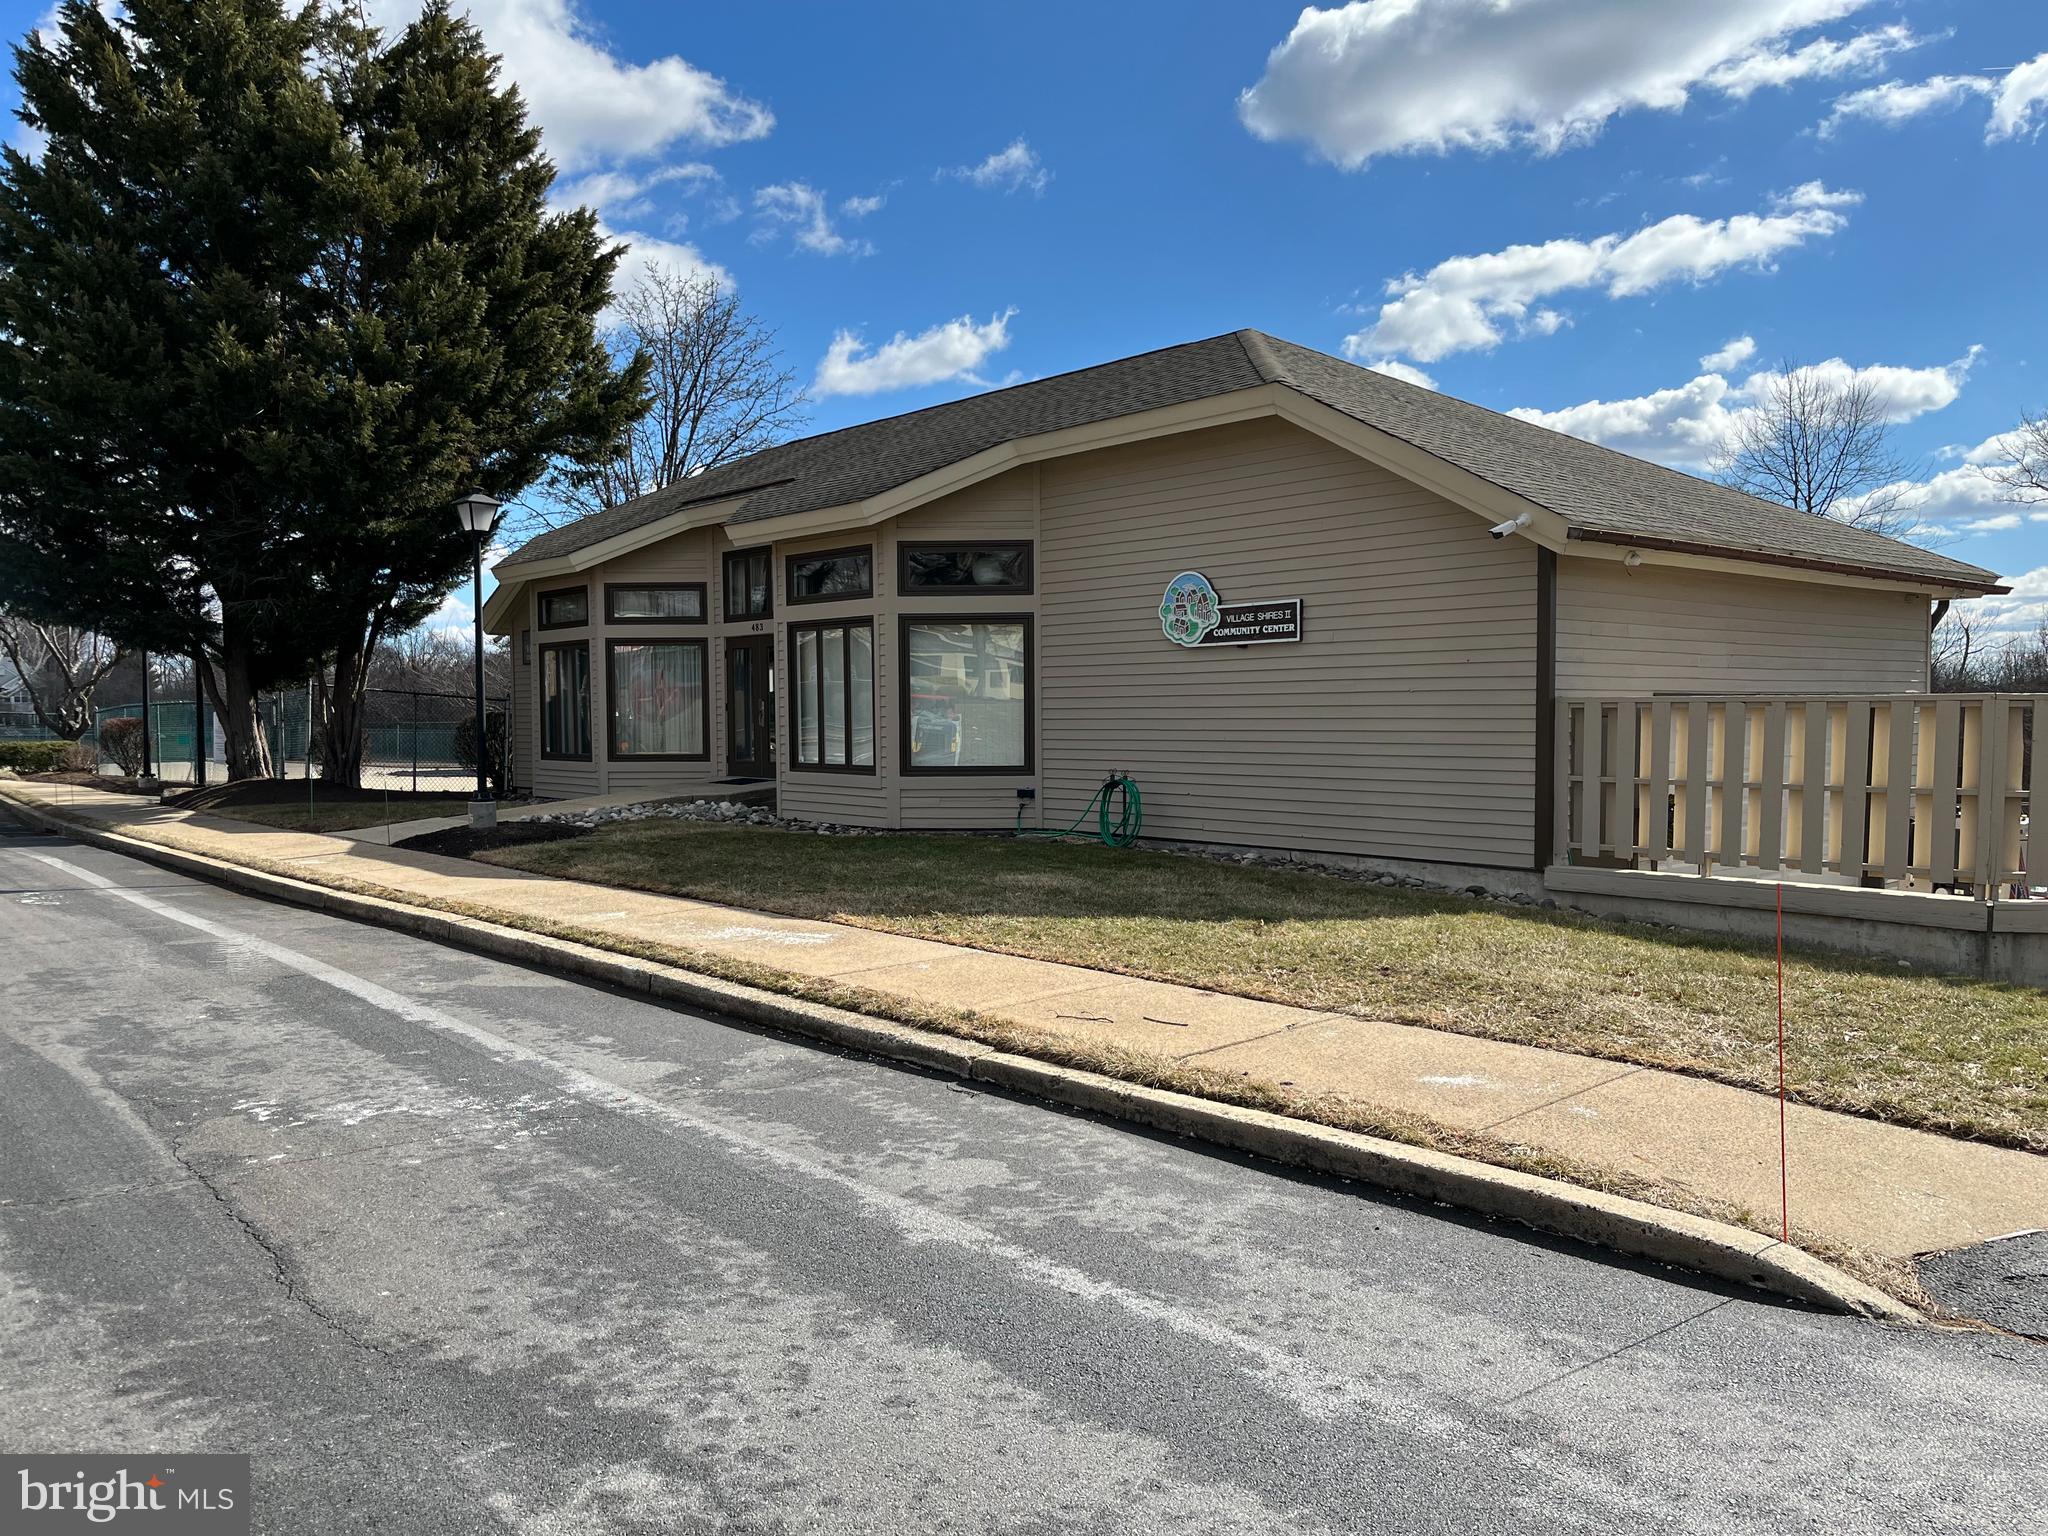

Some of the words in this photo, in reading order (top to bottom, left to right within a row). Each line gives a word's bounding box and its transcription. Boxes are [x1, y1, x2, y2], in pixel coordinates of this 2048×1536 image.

[1226, 613, 1254, 622] VILLAGE
[1258, 611, 1283, 620] SHIRES
[752, 623, 764, 631] 483
[1213, 626, 1260, 636] COMMUNITY
[1263, 624, 1295, 633] CENTER
